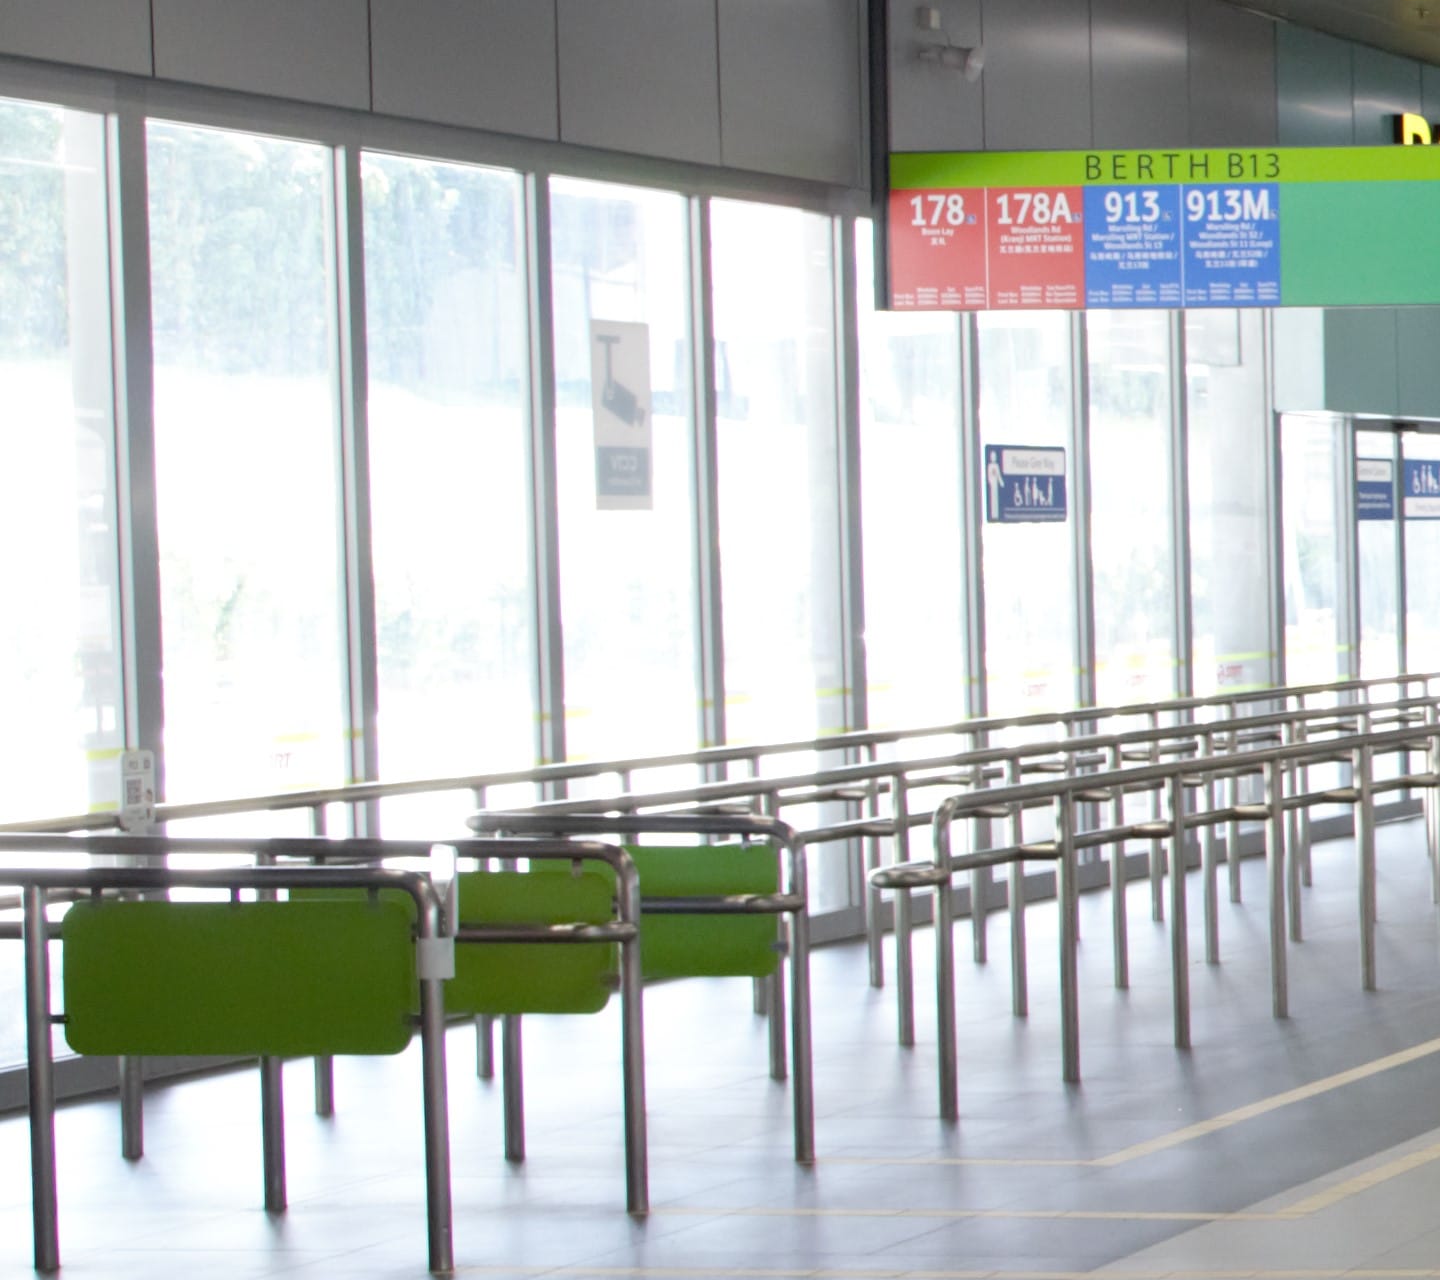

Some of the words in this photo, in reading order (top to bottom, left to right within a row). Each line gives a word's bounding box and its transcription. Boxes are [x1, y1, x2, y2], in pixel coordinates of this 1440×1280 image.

[1085, 154, 1209, 180] BERTH
[1228, 153, 1280, 178] B13
[911, 194, 965, 226] 178
[996, 192, 1072, 225] 178A
[1104, 191, 1160, 222] 913
[1186, 189, 1269, 221] 913M
